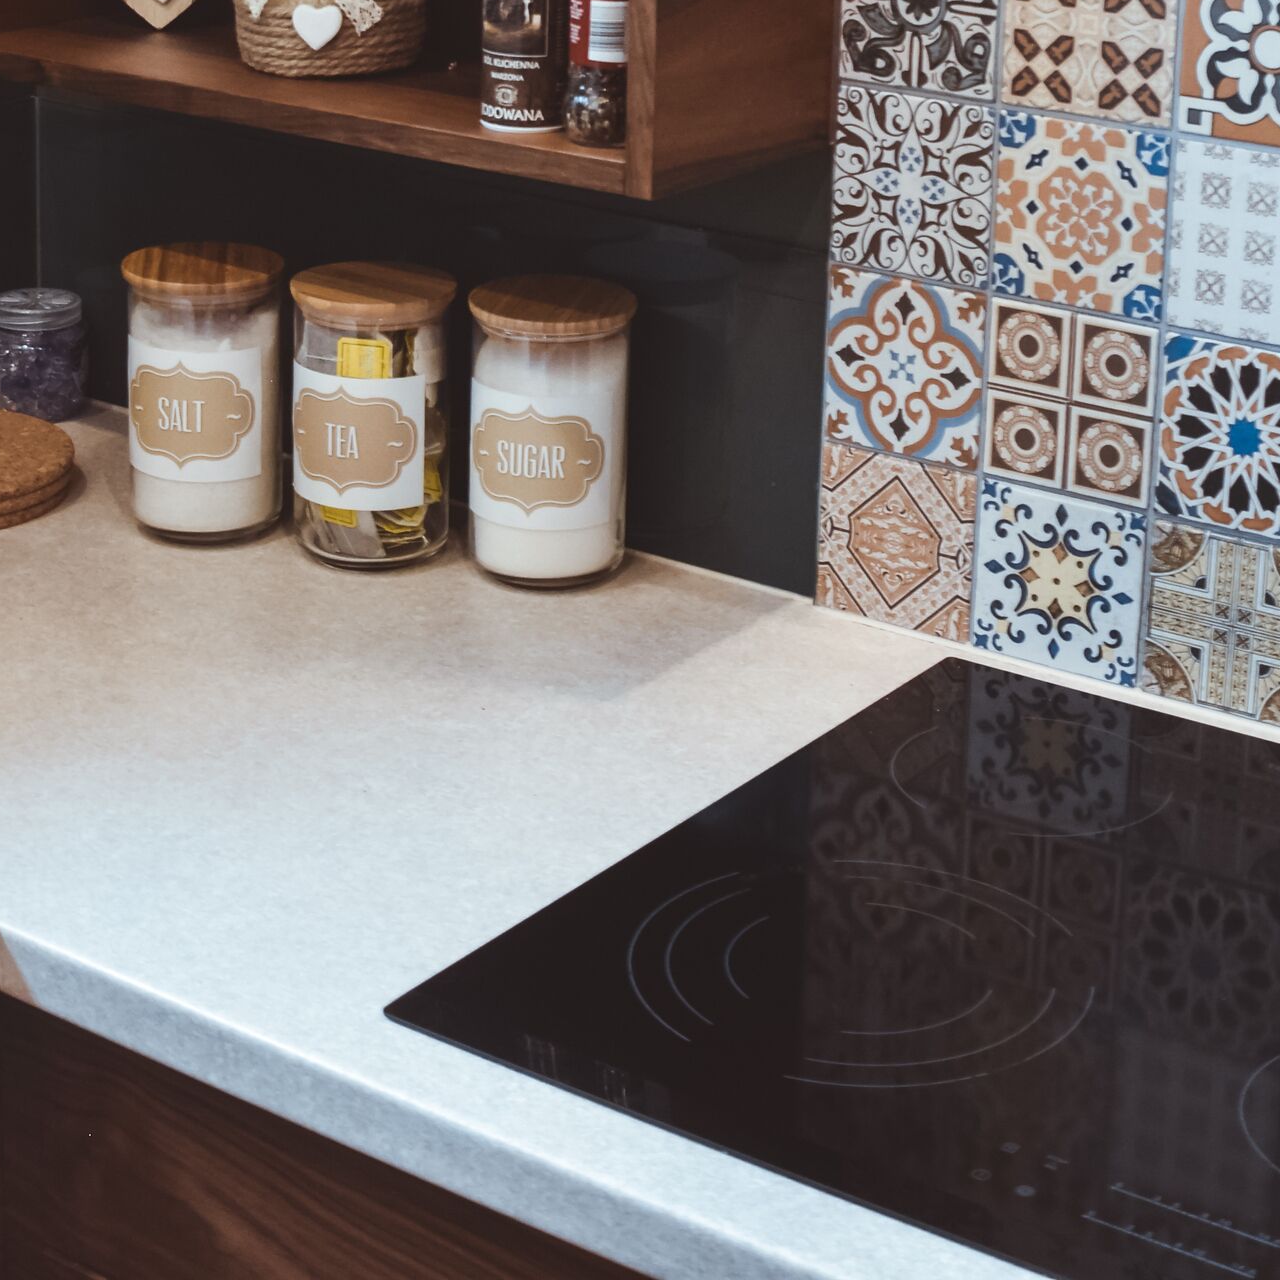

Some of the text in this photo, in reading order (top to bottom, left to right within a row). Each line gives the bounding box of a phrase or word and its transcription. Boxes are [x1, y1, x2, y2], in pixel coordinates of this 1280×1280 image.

[158, 396, 205, 433] SALT
[325, 422, 359, 459] TEA
[496, 439, 566, 479] SUGAR
